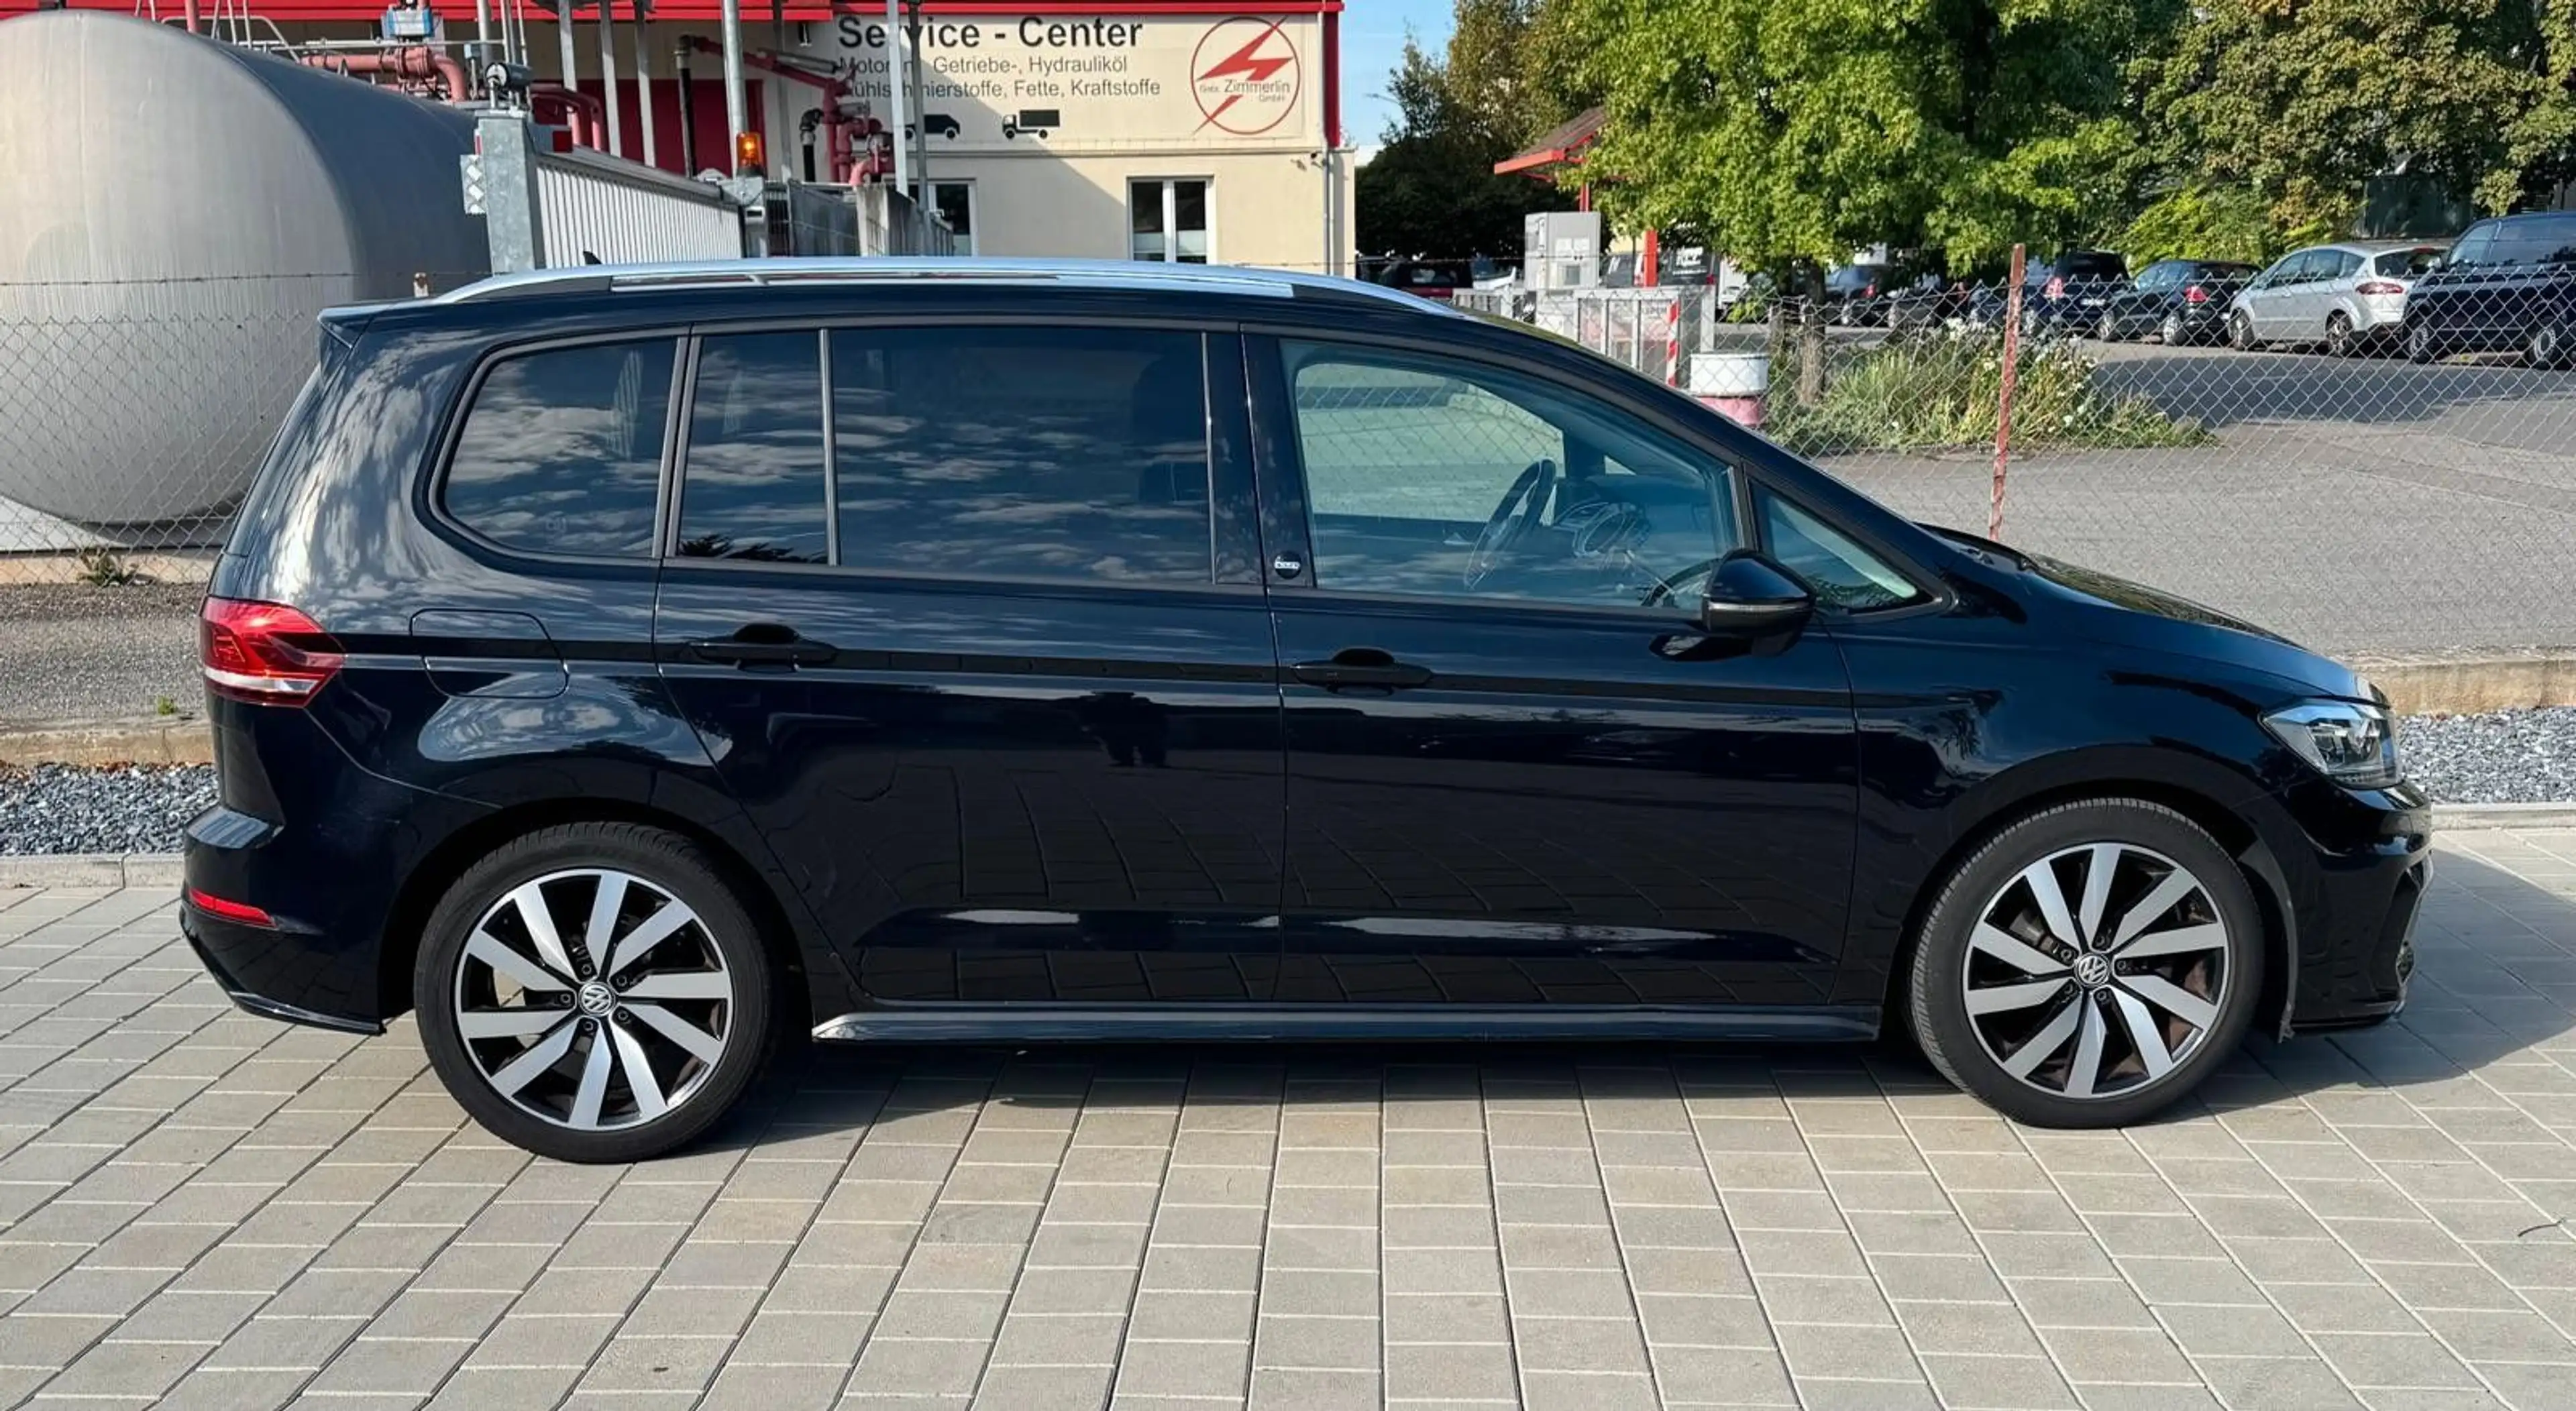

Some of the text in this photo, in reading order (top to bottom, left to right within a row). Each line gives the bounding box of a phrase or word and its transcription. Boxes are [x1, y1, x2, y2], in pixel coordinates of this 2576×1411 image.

[839, 16, 980, 48] Sevice
[1019, 16, 1143, 47] Center
[933, 56, 1022, 74] Getriebe-,
[1028, 56, 1128, 76] Hydrauliköl
[851, 78, 1161, 98] ühlshierstoffe, Fette, Kraftstoffe
[1224, 79, 1290, 93] Zimmerlin
